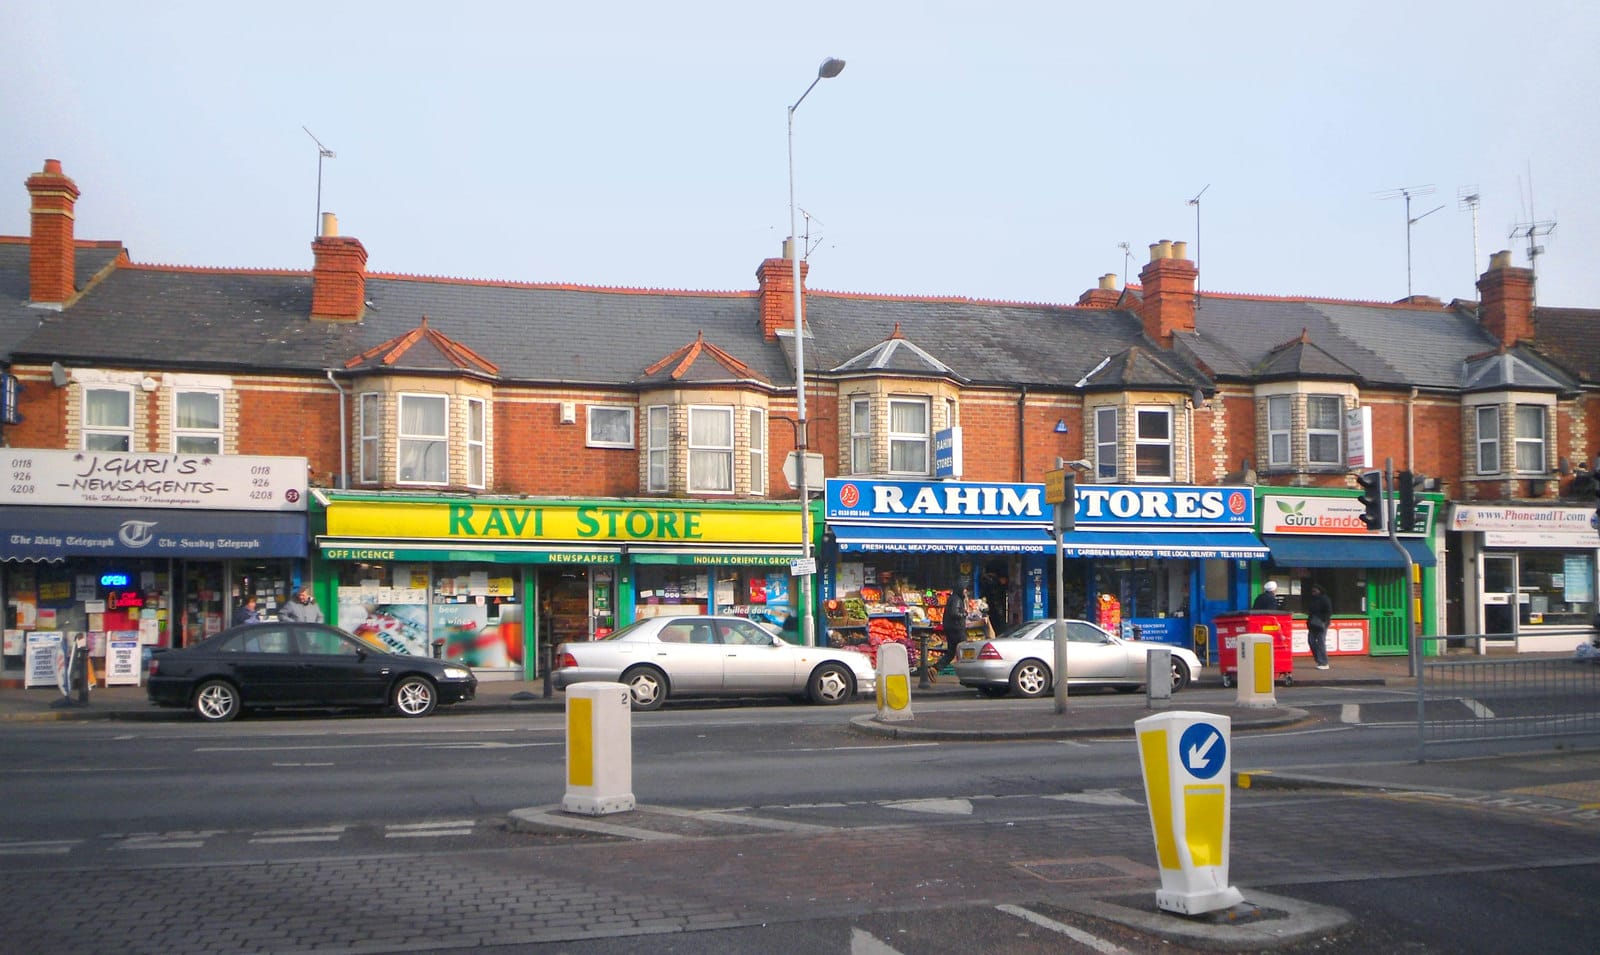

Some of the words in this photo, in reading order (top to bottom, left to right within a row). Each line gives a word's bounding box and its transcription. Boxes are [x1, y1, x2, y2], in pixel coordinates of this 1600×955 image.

[936, 438, 953, 450] RAHIM
[11, 459, 32, 468] 0118
[936, 456, 953, 470] STORES
[13, 471, 32, 481] 926
[251, 466, 271, 475] 0118
[252, 478, 270, 487] 926
[10, 484, 35, 494] 4208
[249, 490, 273, 500] 4208
[287, 491, 298, 501] 53
[872, 486, 1043, 517] RAHIM
[1074, 489, 1225, 519] TORES
[449, 503, 544, 537] RAVI
[1284, 513, 1318, 526] Guru
[1477, 509, 1587, 522] www.PhoneandIT.com
[576, 506, 703, 539] STORE
[10, 535, 31, 545] The
[34, 536, 62, 547] Daily
[65, 536, 114, 548] Telegraph
[158, 538, 177, 548] The
[180, 538, 215, 550] Sunday
[216, 539, 260, 550] Telegraph
[328, 551, 349, 559] OFF
[351, 551, 395, 560] LICENCE
[549, 554, 615, 563] NEWSPAPERS
[694, 556, 721, 564] INDIAN
[731, 556, 767, 565] ORIENTAL
[101, 575, 127, 586] OPEN
[722, 605, 750, 615] chilled
[751, 606, 772, 617] dairy
[621, 692, 629, 705] 2
